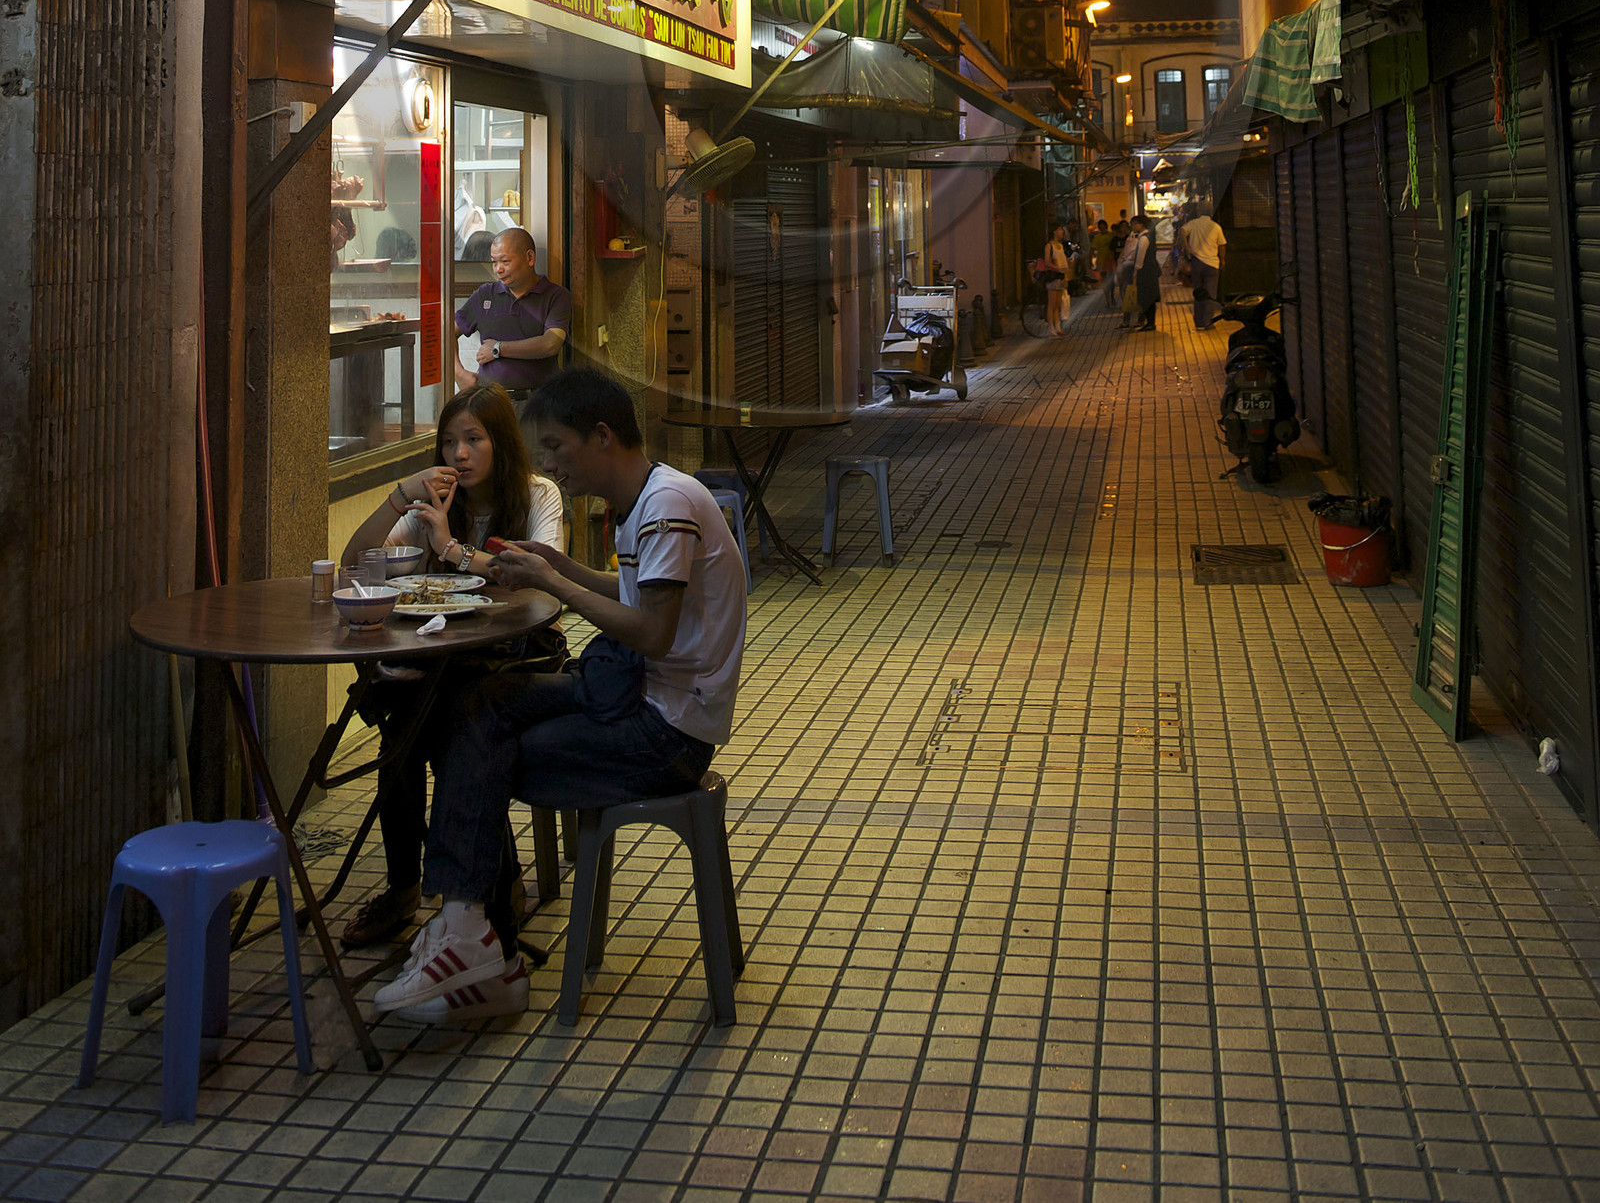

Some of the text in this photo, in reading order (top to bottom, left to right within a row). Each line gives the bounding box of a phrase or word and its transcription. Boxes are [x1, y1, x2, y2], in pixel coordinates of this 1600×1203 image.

[671, 19, 685, 49] LUN
[687, 26, 705, 56] TSAN
[706, 34, 718, 61] FAN
